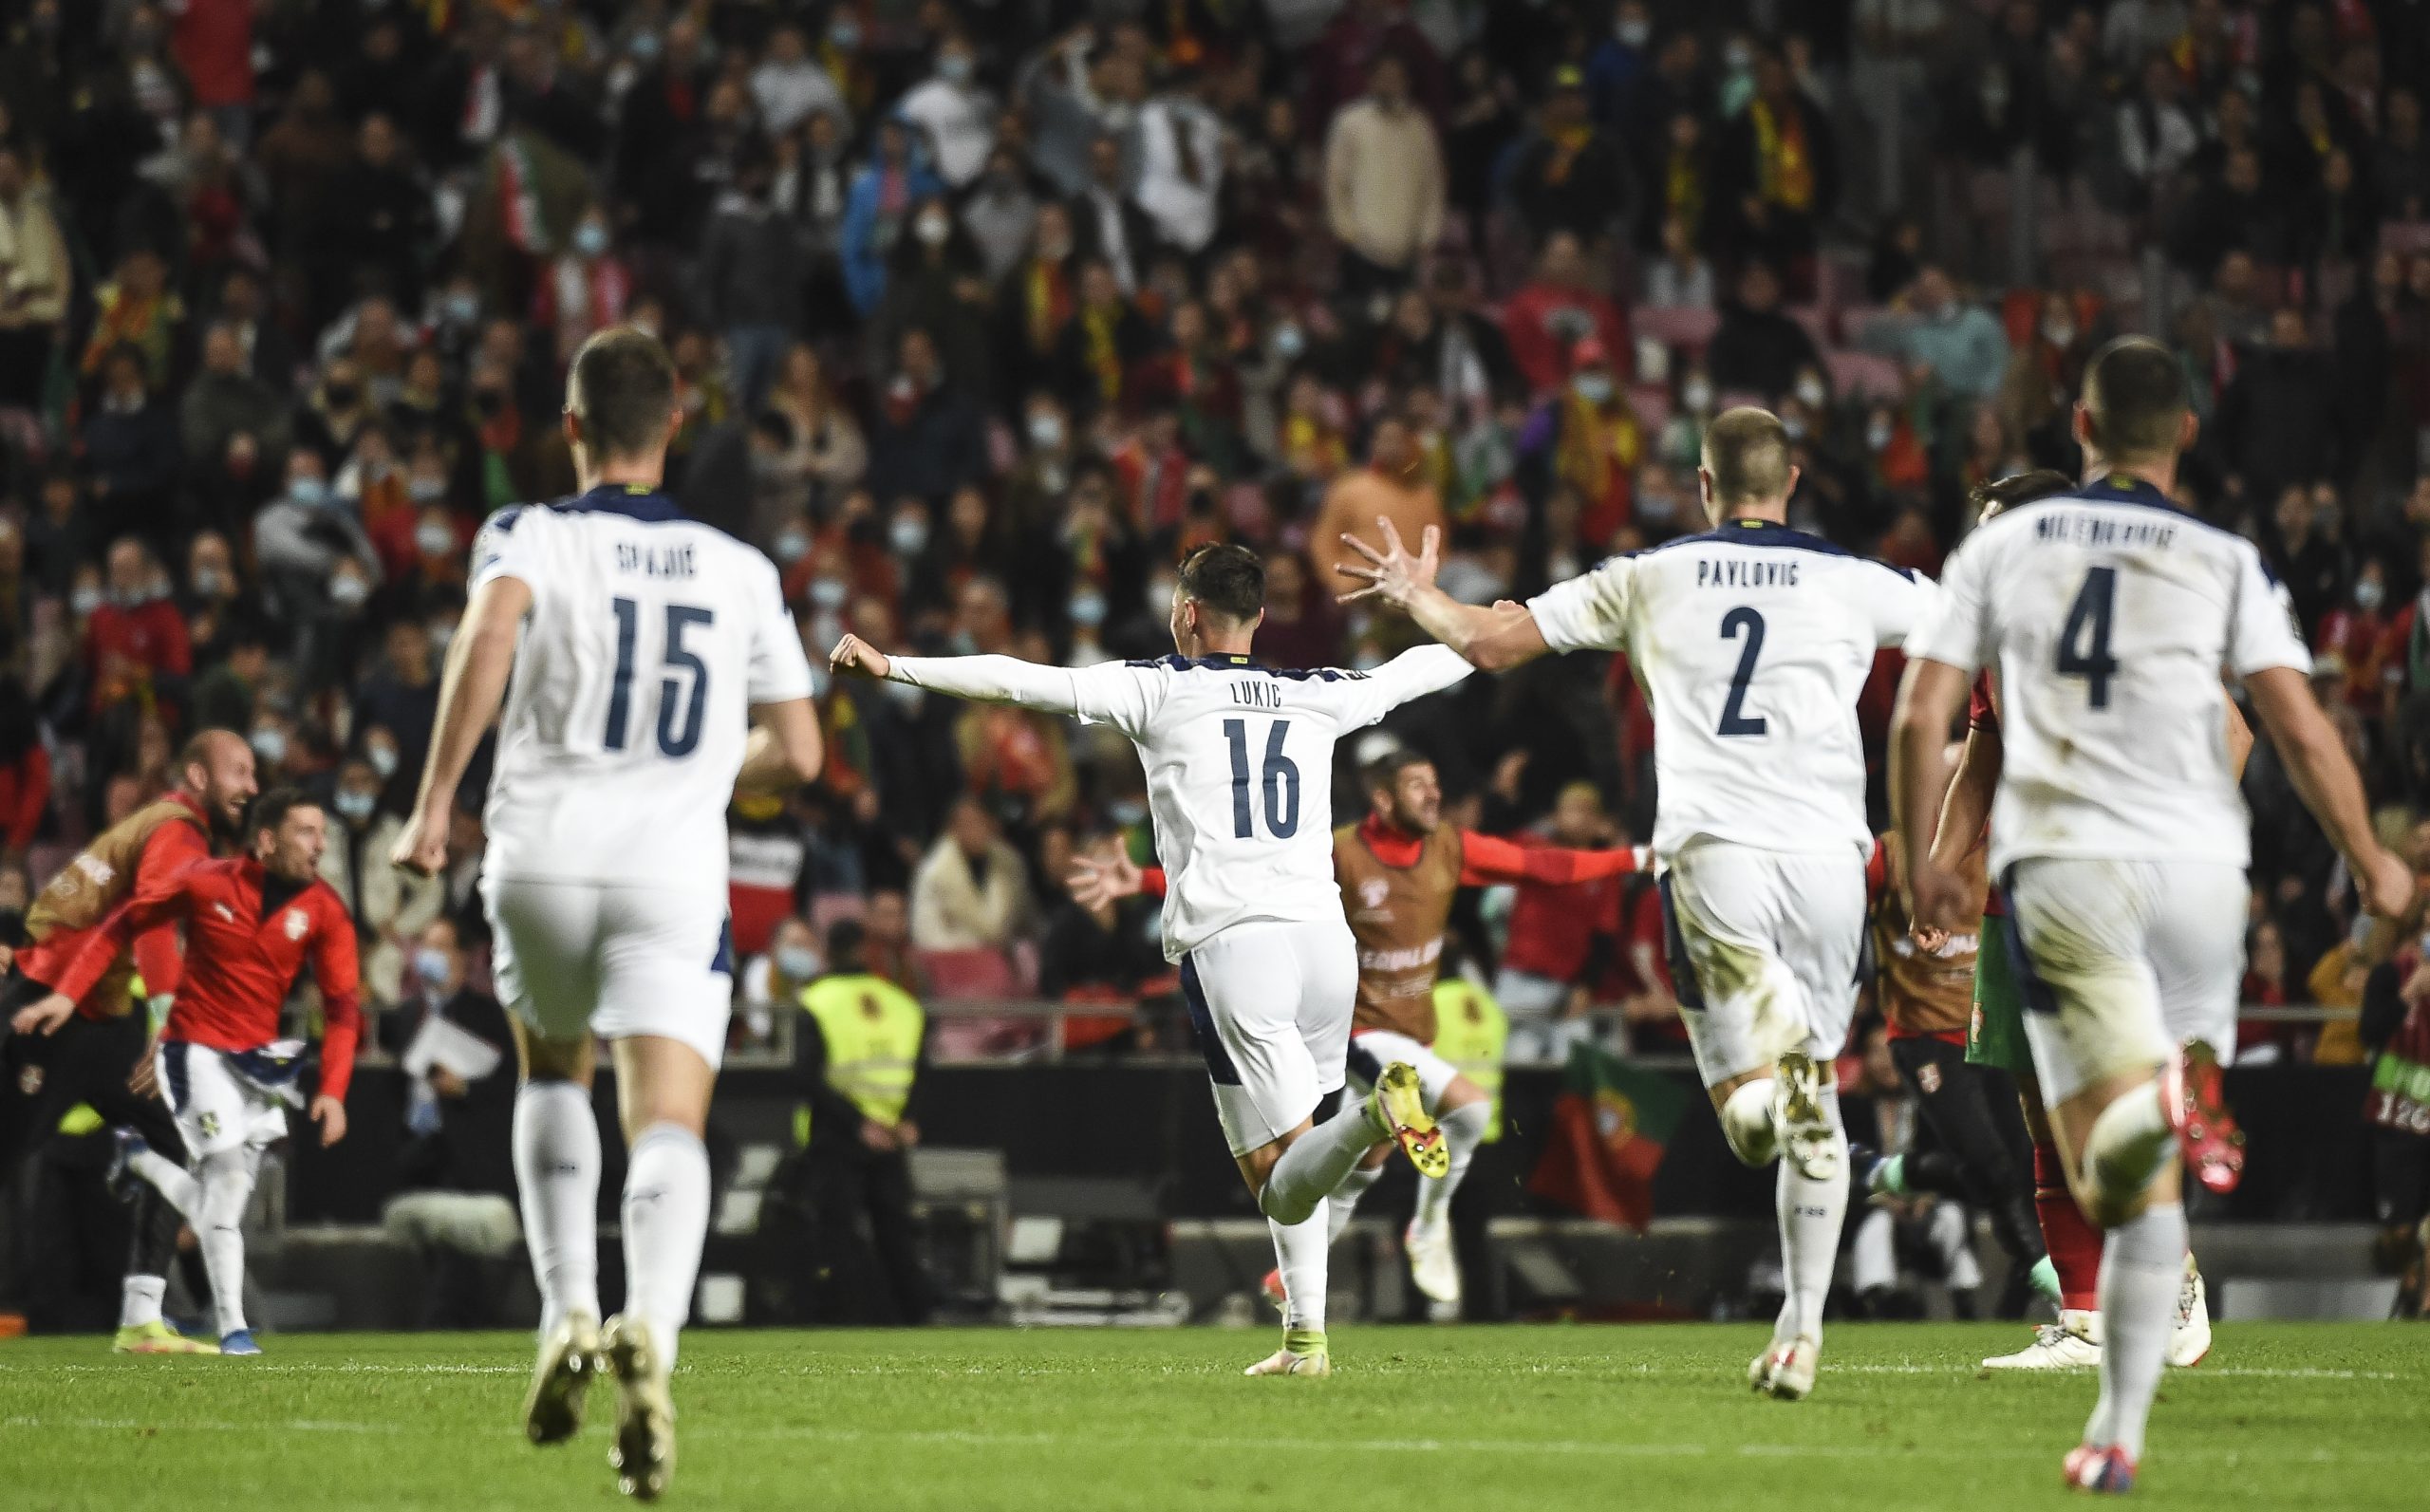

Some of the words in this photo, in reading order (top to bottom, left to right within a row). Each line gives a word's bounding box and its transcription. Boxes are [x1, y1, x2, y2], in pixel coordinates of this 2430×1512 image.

[1697, 559, 1800, 588] PAVLOVIĆ
[605, 597, 714, 757] 15
[1717, 607, 1766, 736] 2
[2057, 567, 2119, 710] 4
[1223, 719, 1300, 839] 16
